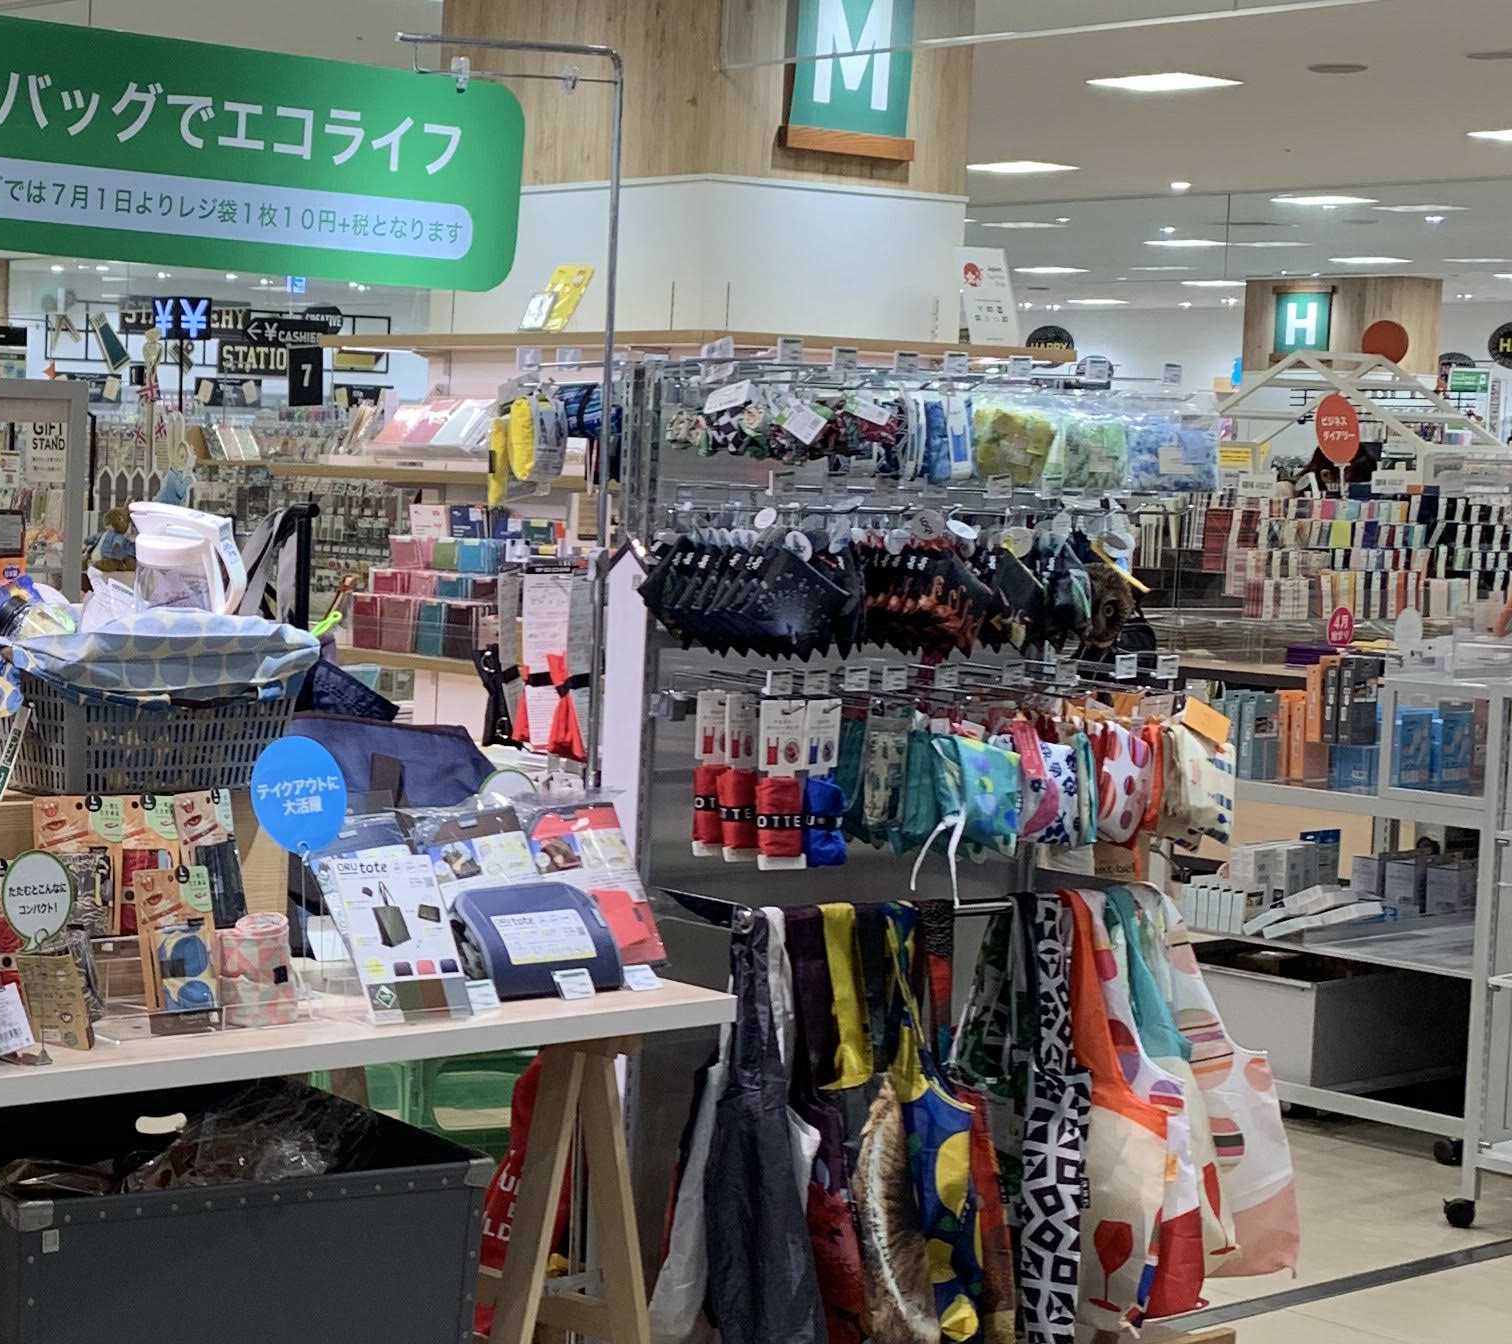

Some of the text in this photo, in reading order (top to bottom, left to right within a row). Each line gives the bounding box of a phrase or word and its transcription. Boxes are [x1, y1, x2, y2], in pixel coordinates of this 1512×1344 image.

[1284, 301, 1318, 346] H
[301, 363, 312, 387] 7
[32, 437, 66, 451] STAND
[256, 775, 340, 801] テイクアウトに
[359, 861, 388, 874] tote
[8, 883, 67, 897] たたむとこんなに
